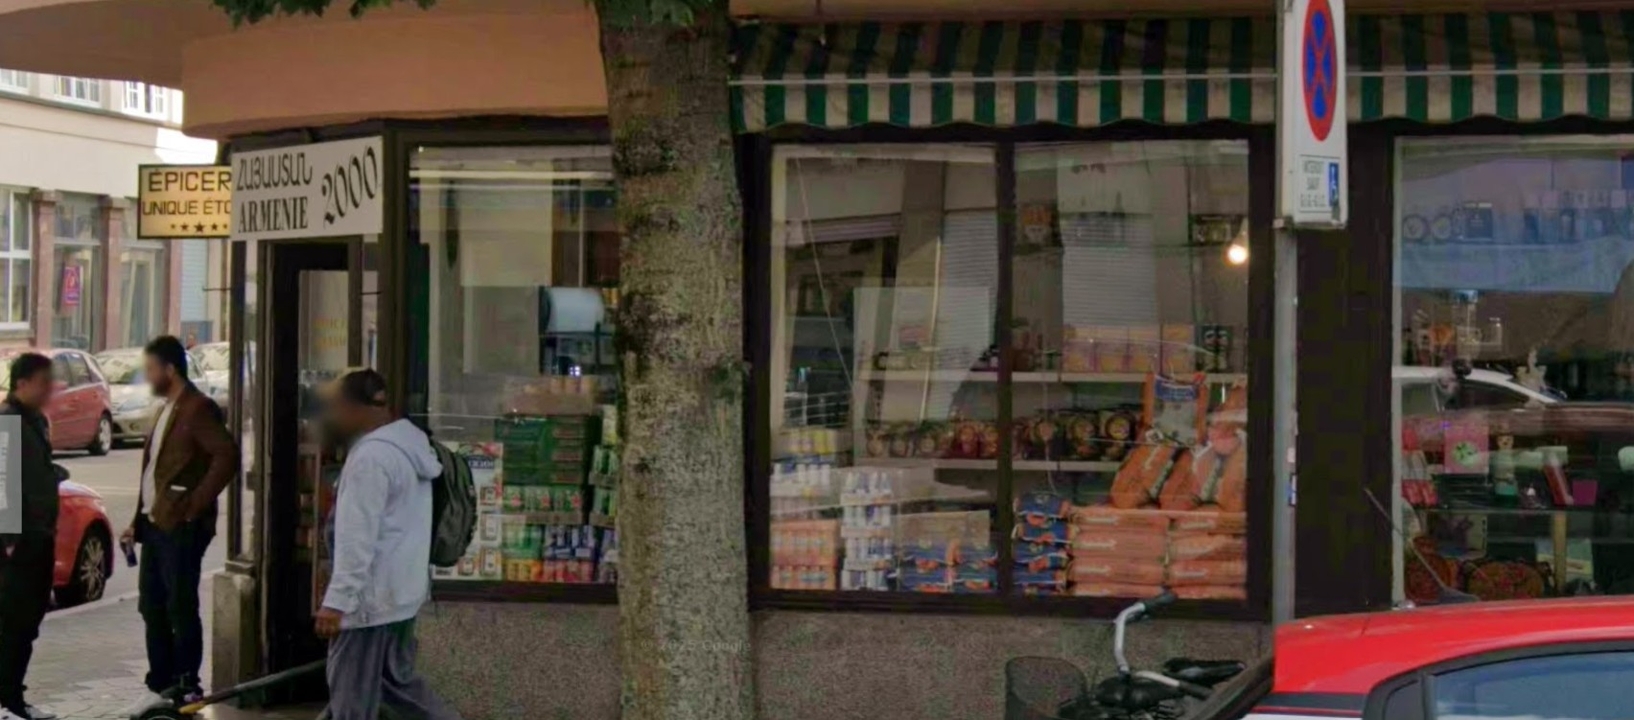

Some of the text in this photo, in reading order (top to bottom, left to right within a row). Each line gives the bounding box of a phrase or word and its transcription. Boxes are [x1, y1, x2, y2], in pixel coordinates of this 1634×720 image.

[321, 146, 378, 229] 2000
[142, 200, 198, 216] UNIQUE
[238, 196, 309, 233] ARMENIE
